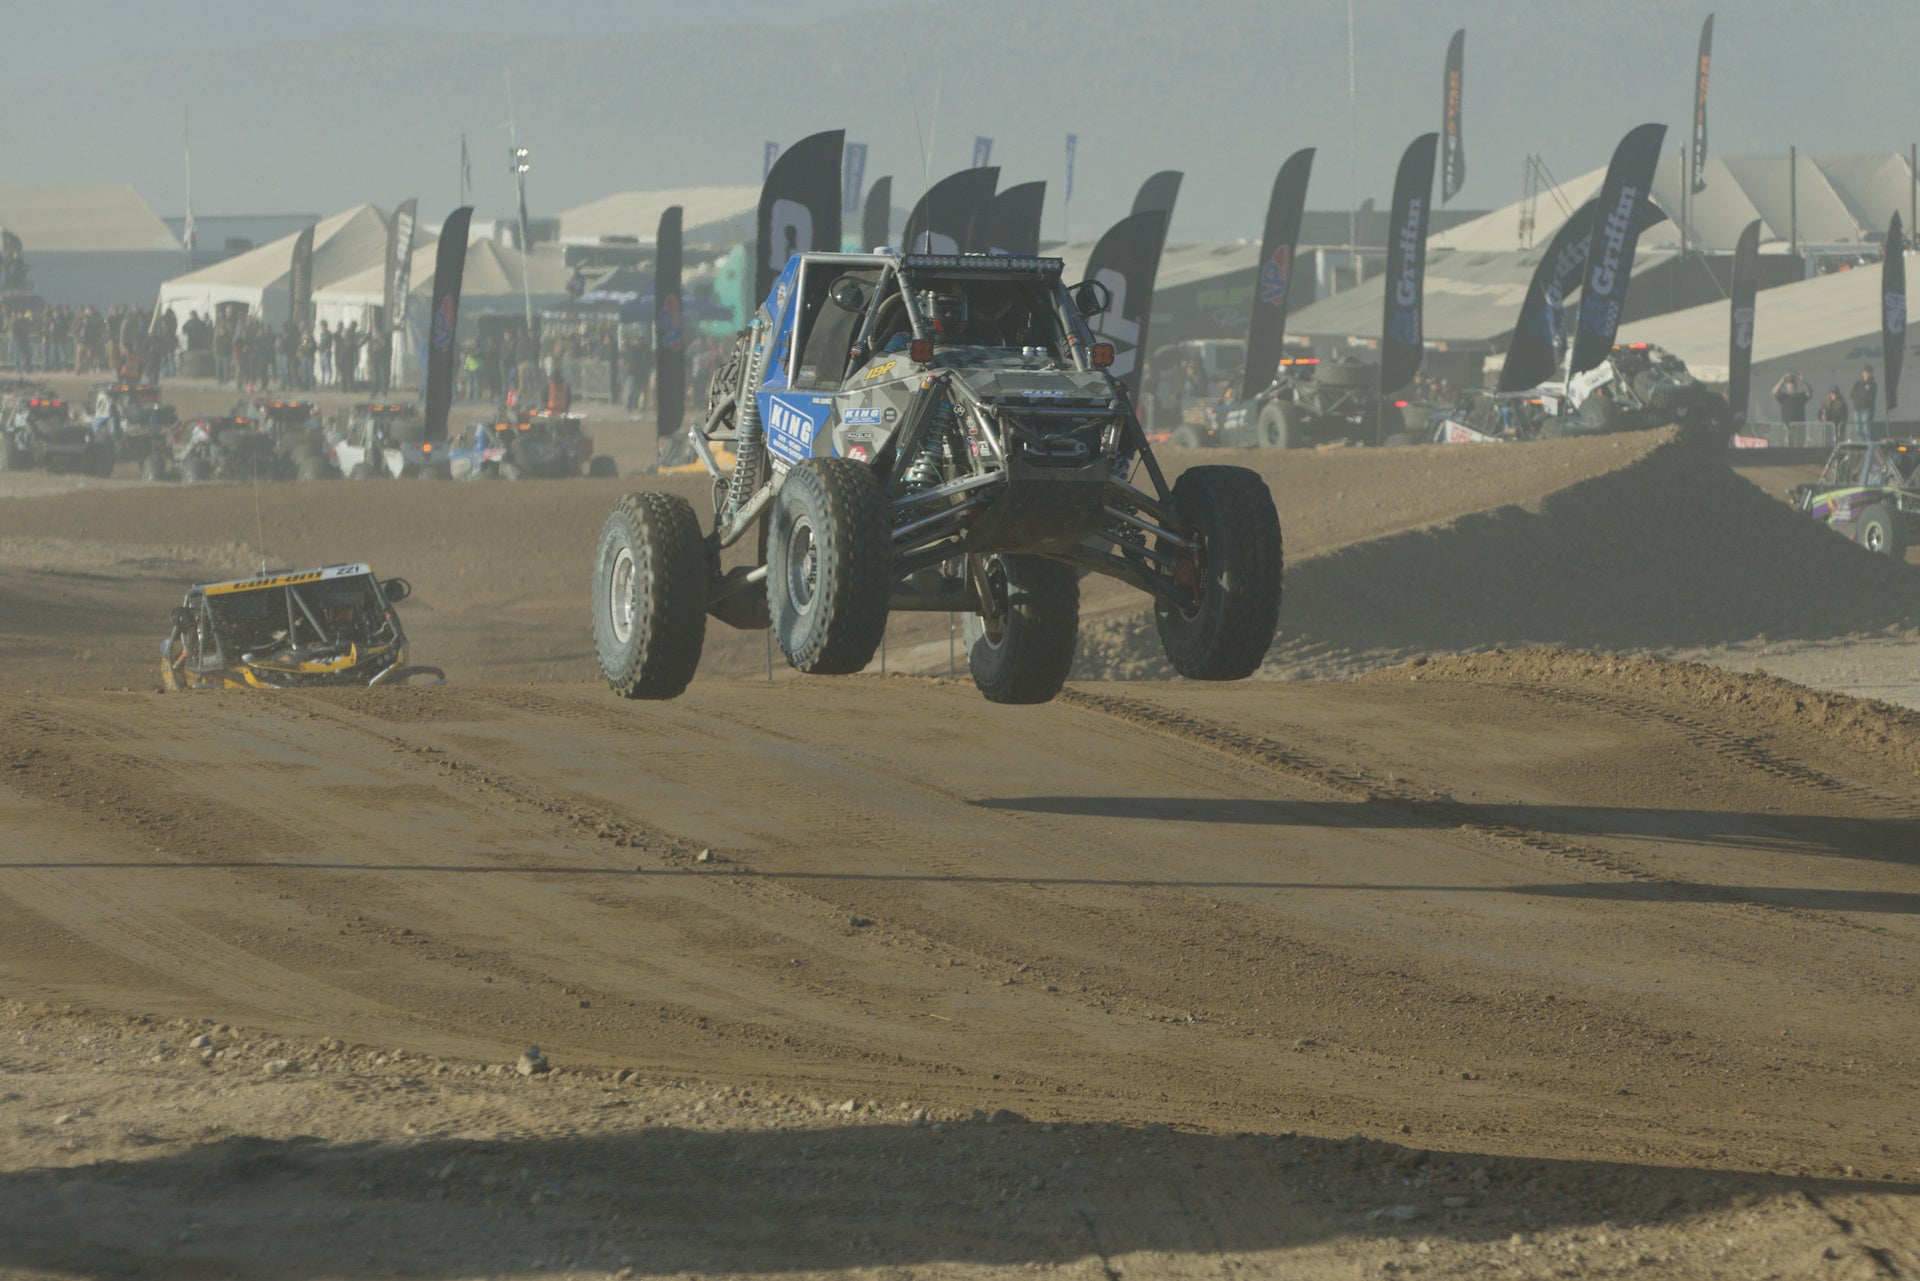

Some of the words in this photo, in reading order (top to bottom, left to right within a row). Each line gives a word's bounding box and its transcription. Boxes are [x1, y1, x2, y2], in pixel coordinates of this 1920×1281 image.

[1396, 198, 1423, 307] Griffin
[1590, 184, 1637, 296] Griffin
[771, 404, 812, 444] KING
[845, 409, 880, 418] KING
